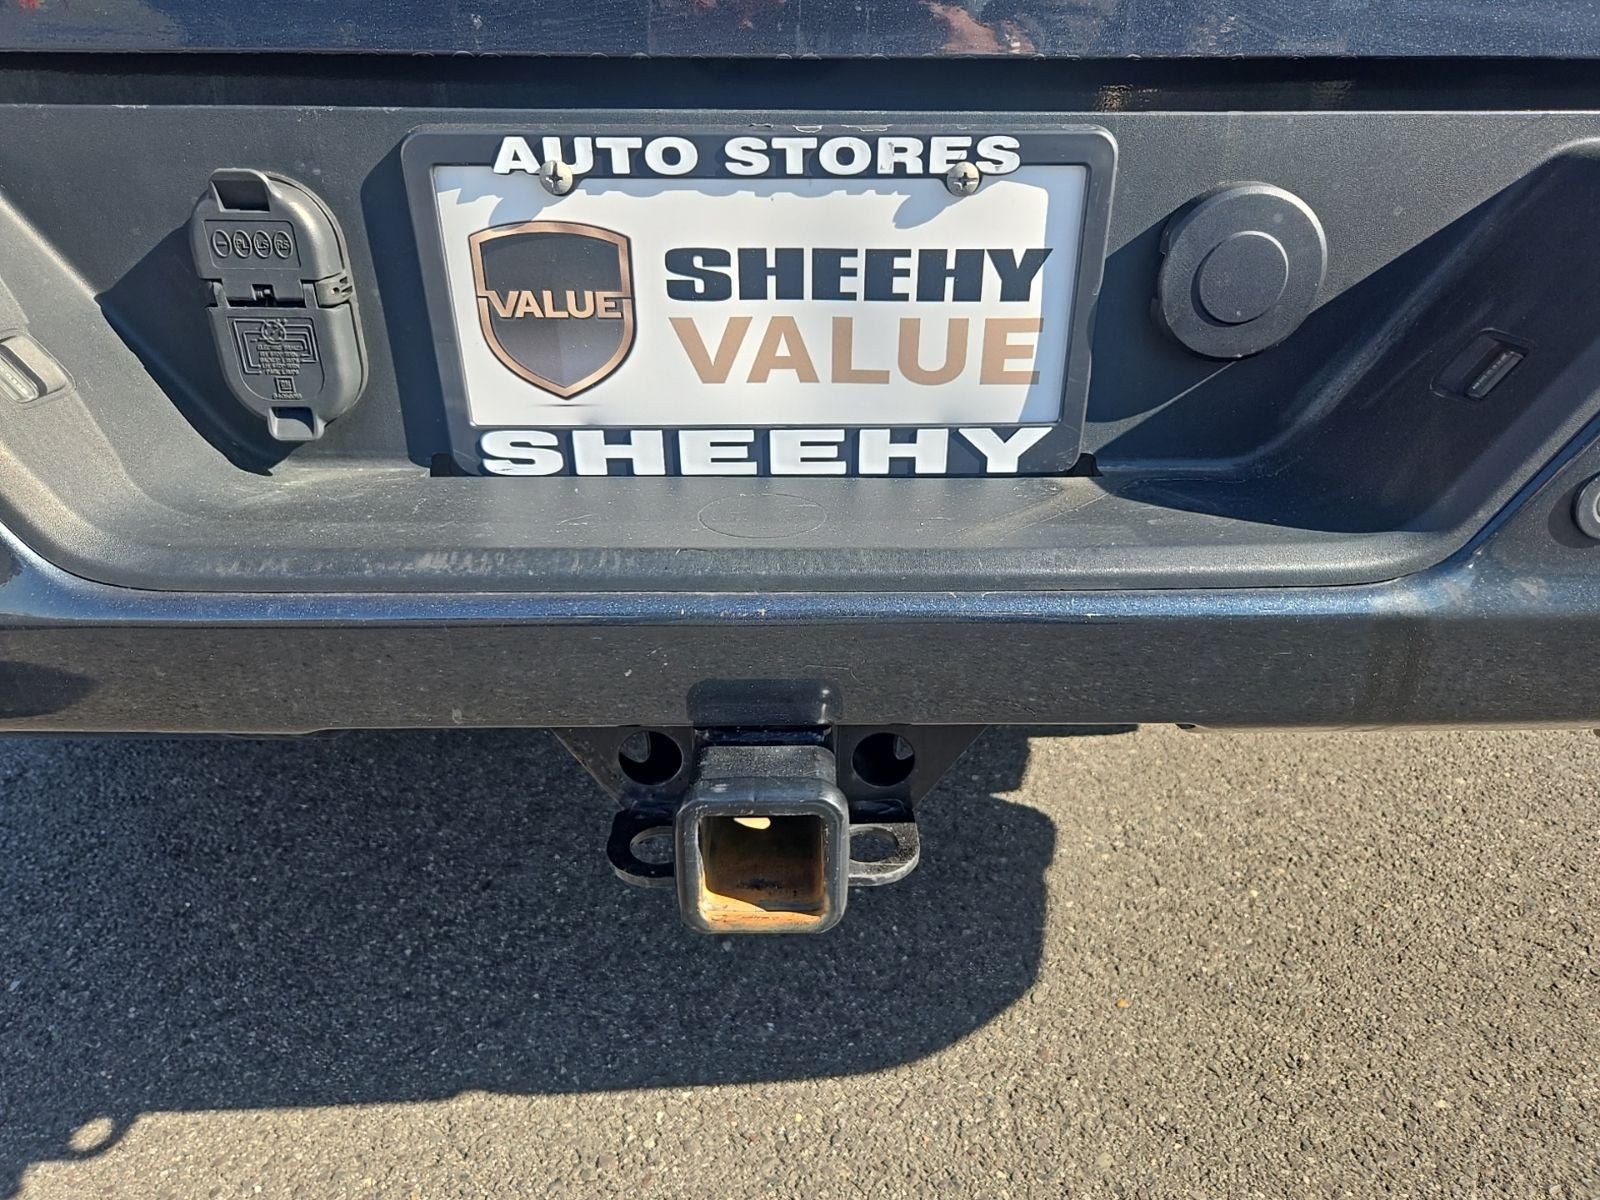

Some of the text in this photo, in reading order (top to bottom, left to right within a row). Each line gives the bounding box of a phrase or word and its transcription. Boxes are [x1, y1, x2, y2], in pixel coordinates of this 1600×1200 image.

[493, 136, 1021, 176] AUTO STORES
[665, 248, 1053, 302] SHEEHY
[486, 290, 623, 318] VALUE
[669, 315, 1044, 385] VALUE
[480, 428, 1053, 476] SHEEHY
